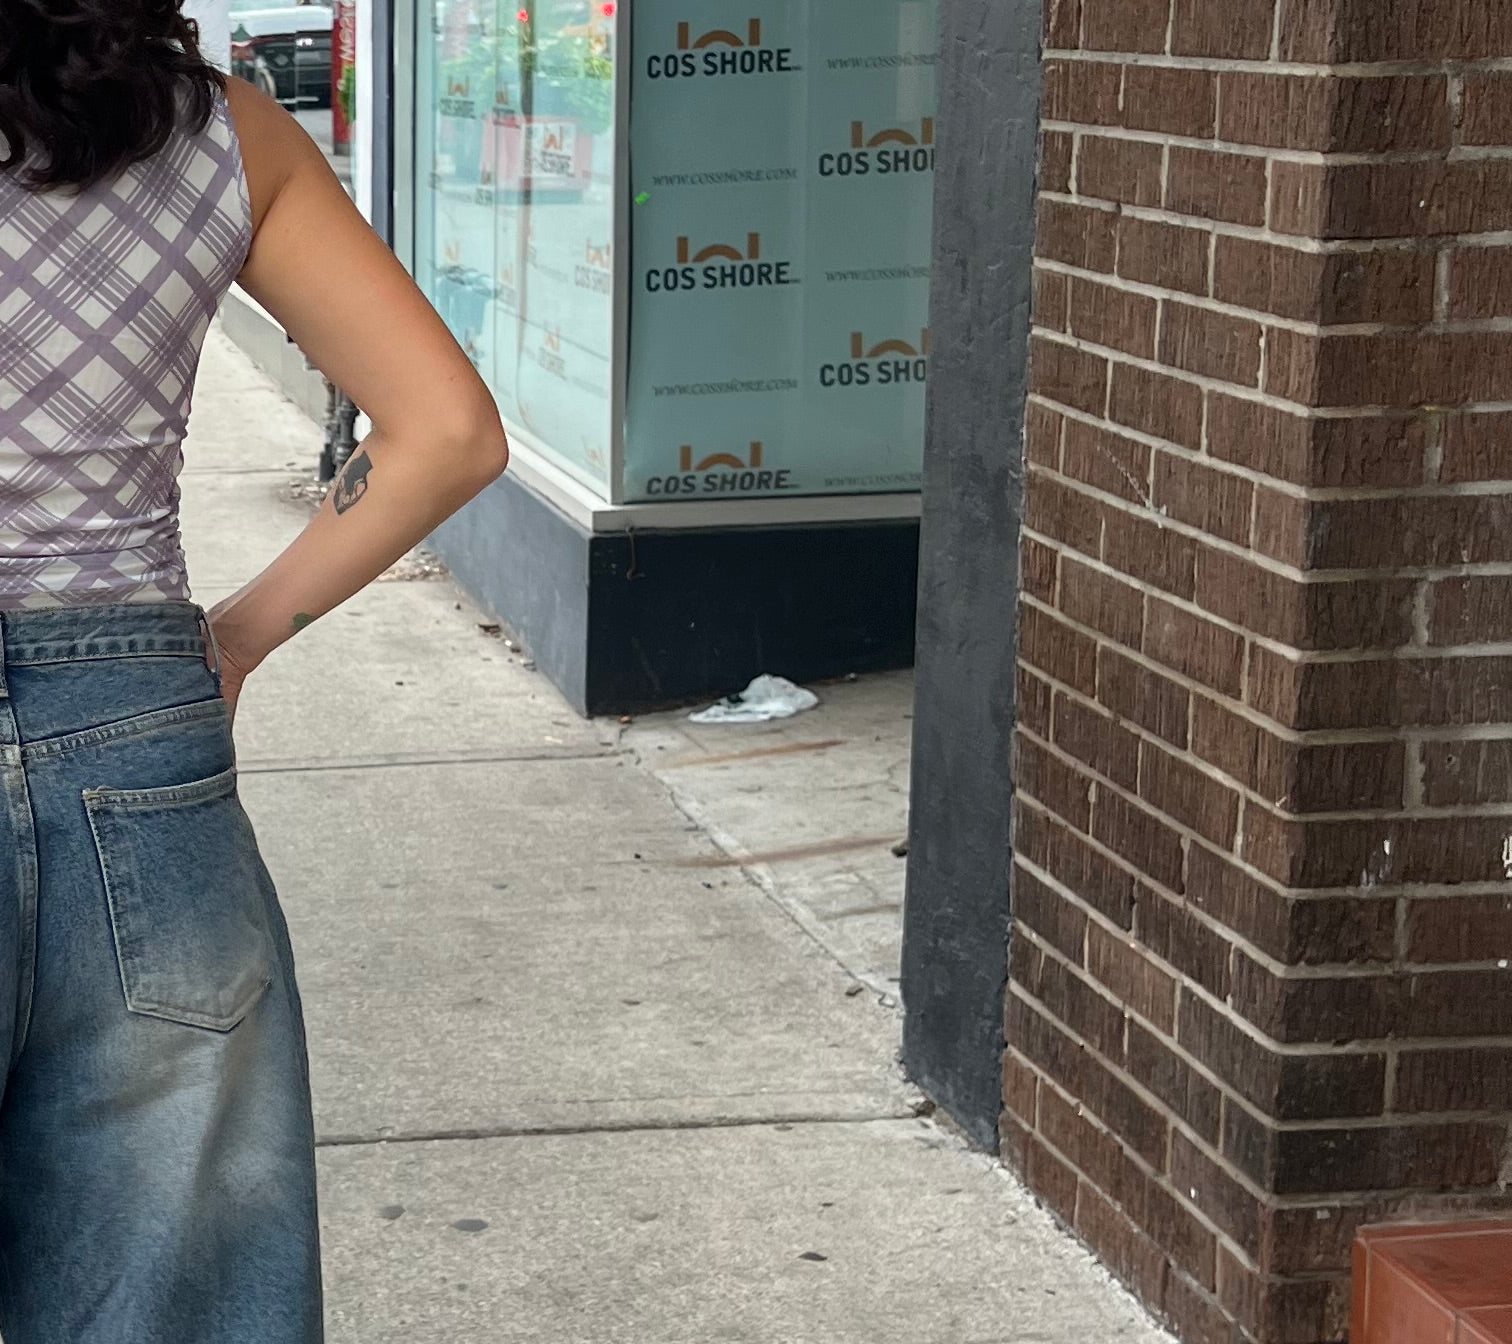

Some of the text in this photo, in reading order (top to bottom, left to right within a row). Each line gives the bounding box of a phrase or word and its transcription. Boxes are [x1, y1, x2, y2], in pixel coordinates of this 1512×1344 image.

[648, 49, 791, 78] COS SHORE
[819, 152, 869, 176] COS
[646, 260, 789, 292] COS SHORE
[820, 363, 869, 386] COS
[647, 468, 793, 495] COS SHORE
